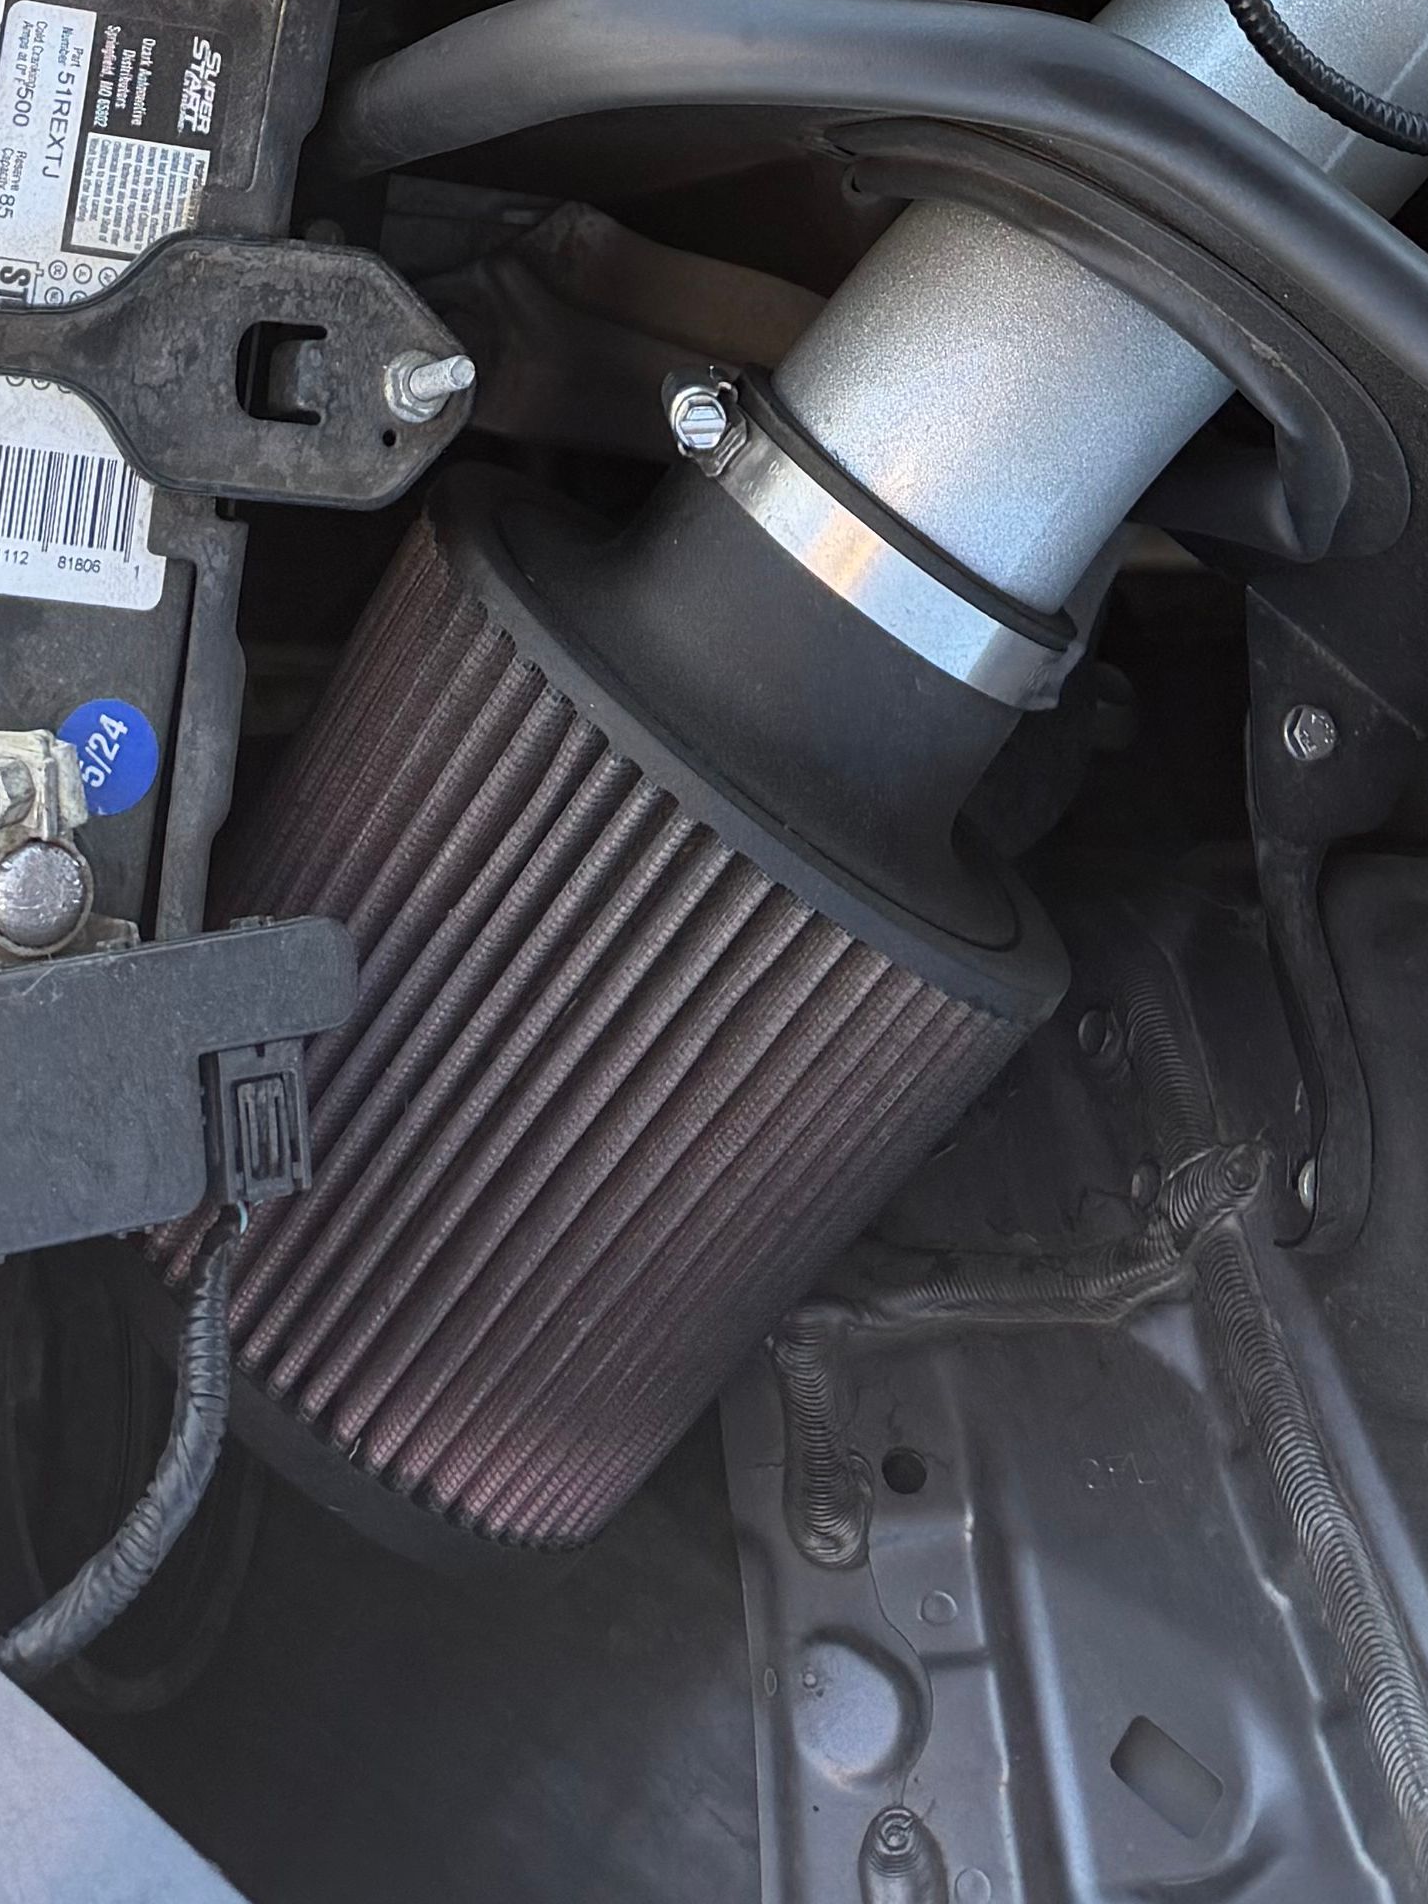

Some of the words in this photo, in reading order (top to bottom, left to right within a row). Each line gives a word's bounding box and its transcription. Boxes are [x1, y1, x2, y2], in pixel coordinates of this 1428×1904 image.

[33, 19, 48, 44] Cold
[57, 26, 74, 66] Number
[139, 37, 156, 66] Ozark
[69, 46, 84, 68] Part
[97, 79, 113, 97] MO
[114, 48, 136, 108] Distributors
[130, 67, 152, 126] Automotive
[184, 35, 211, 134] START
[199, 51, 222, 134] SUPER
[12, 87, 35, 128] 500
[41, 70, 75, 178] 51REXTJ
[56, 555, 101, 573] 81806
[133, 564, 139, 579] 1
